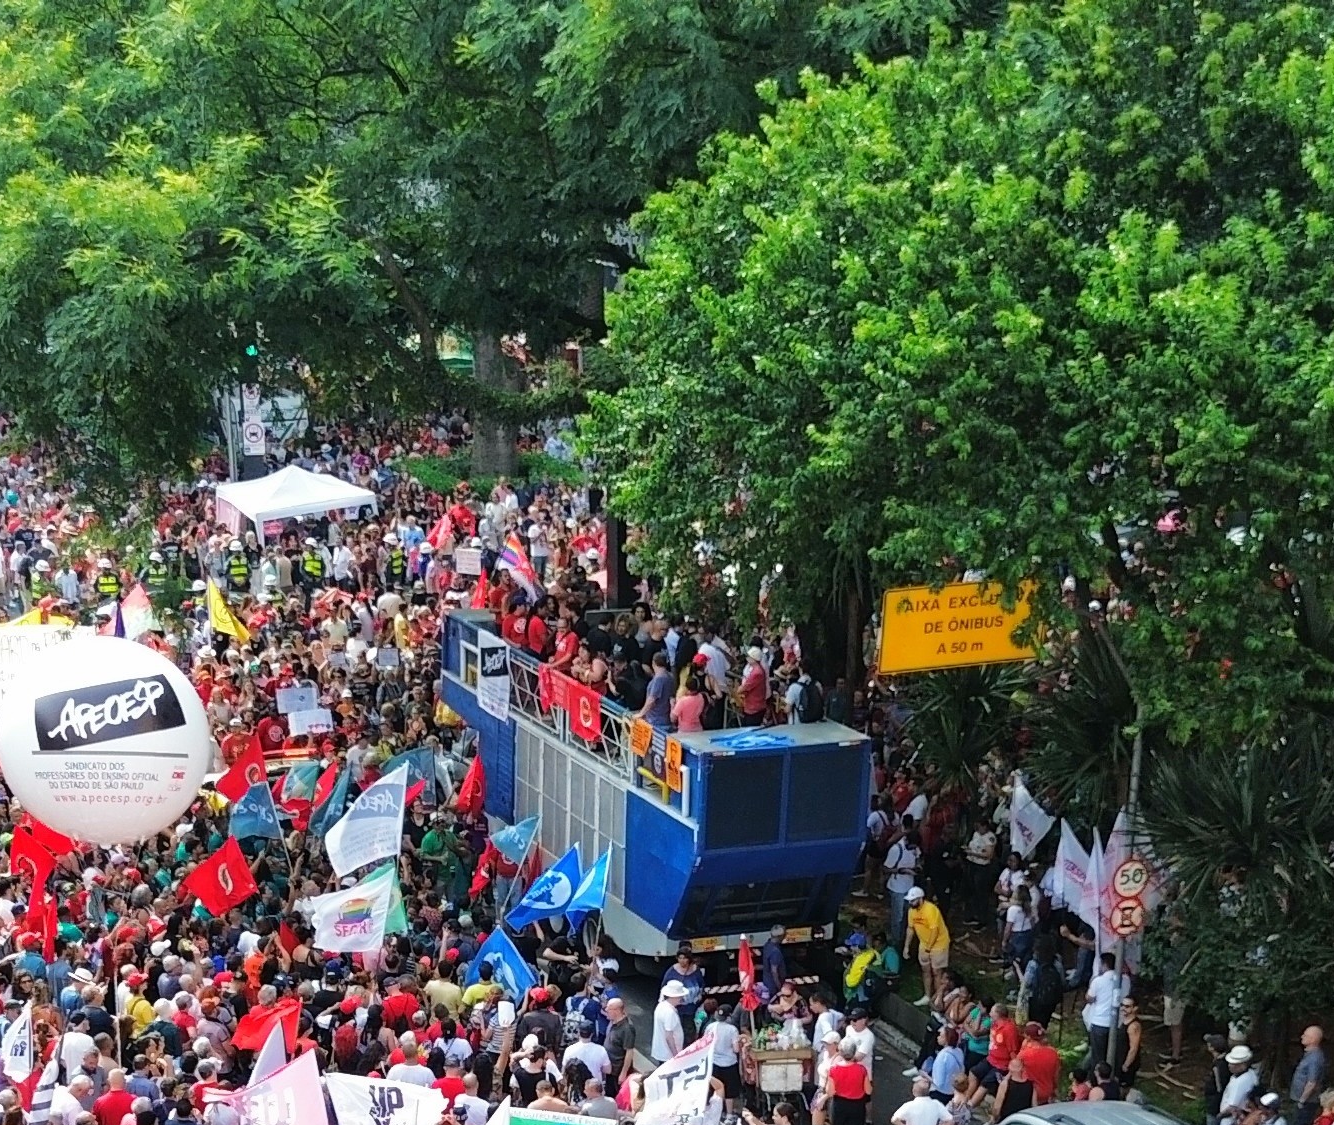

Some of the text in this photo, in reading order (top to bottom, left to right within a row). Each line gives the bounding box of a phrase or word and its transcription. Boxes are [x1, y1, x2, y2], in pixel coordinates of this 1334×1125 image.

[924, 615, 1004, 635] DE ÔNIBUS
[936, 642, 983, 655] A 50 m
[47, 680, 165, 742] APEOESP
[64, 761, 125, 771] SINDICATO DOS
[35, 771, 160, 782] PROFESSORES DO ENSINO OFICIAL
[48, 781, 59, 790] DO
[60, 781, 90, 790] ESTADO
[92, 781, 102, 790] DE
[120, 781, 144, 791] PAULO
[1120, 868, 1144, 886] 50
